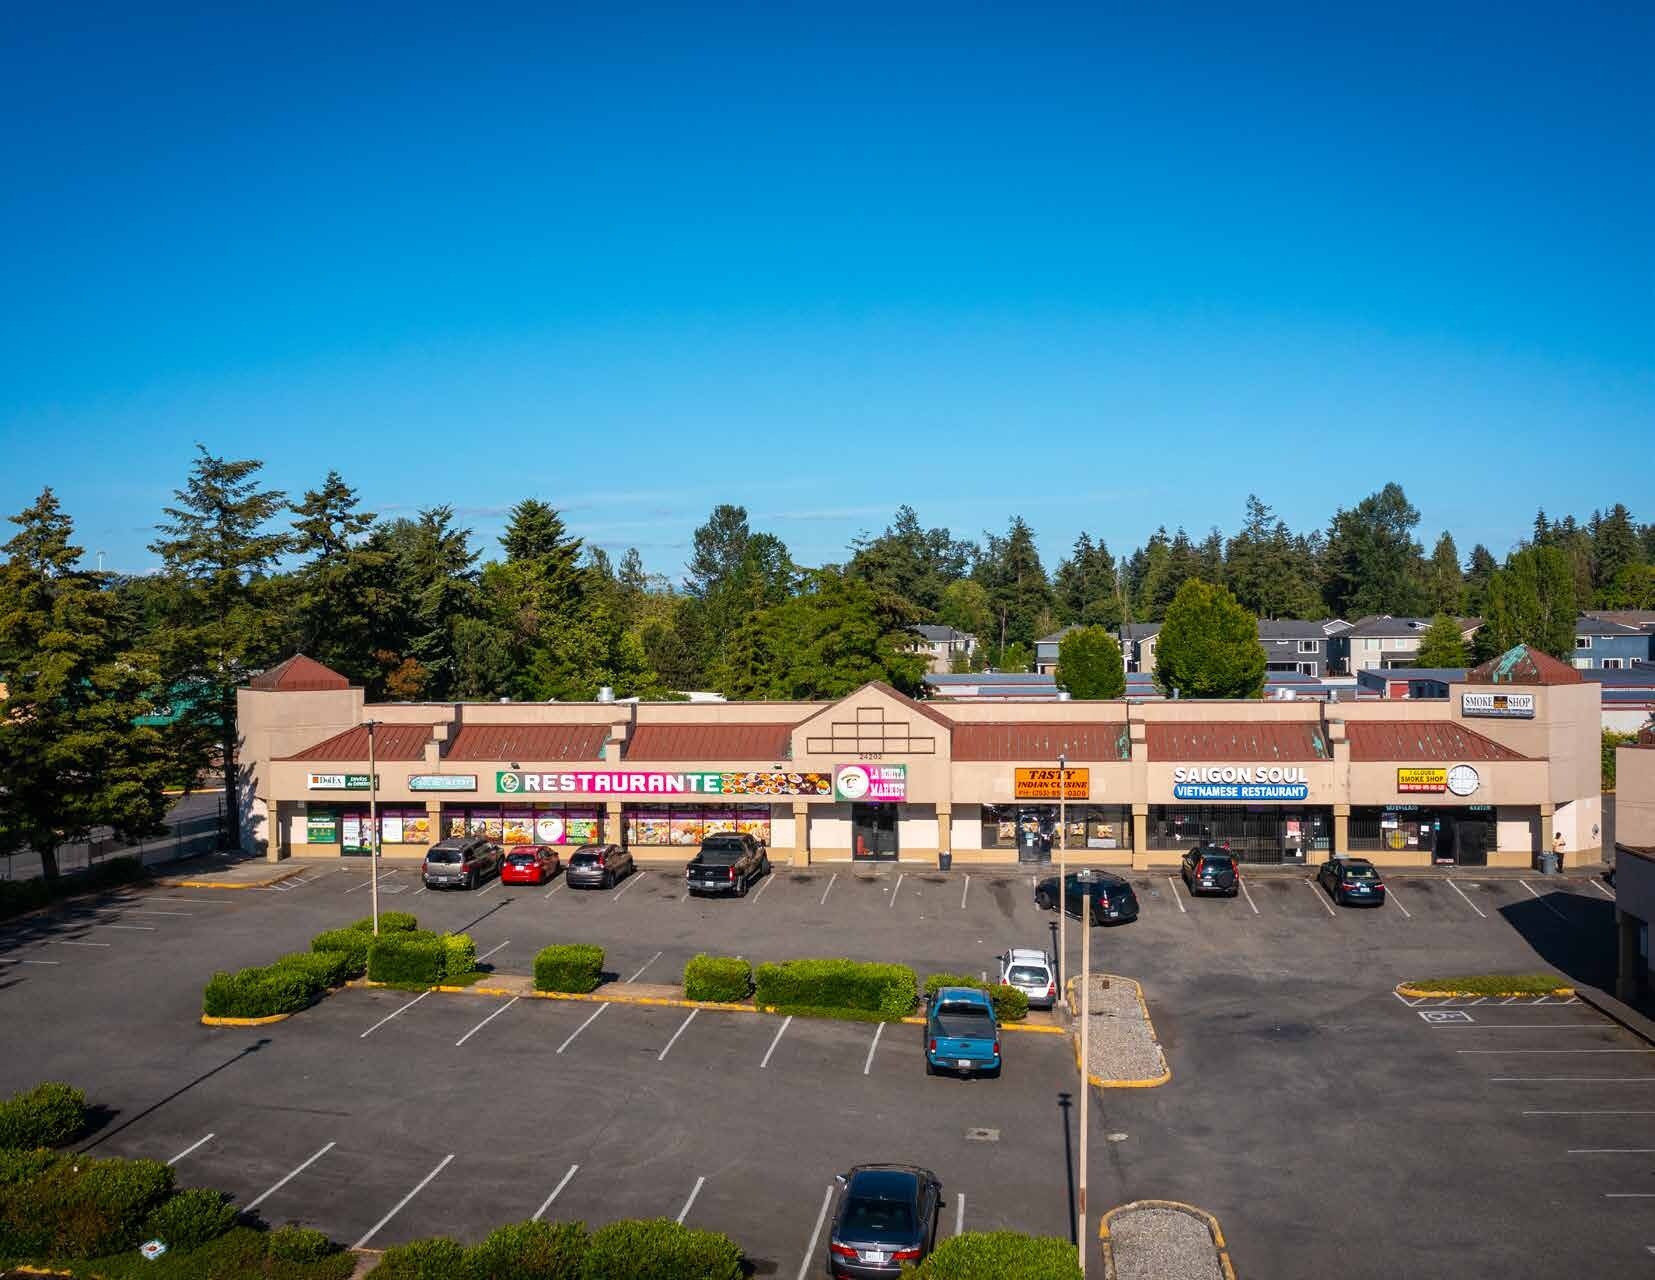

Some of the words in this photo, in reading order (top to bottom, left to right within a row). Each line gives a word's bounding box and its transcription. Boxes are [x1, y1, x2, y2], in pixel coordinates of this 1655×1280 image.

[1465, 696, 1493, 707] SMOKE
[1508, 697, 1531, 708] SHOP
[869, 768, 879, 780] LA
[1028, 770, 1076, 780] TASTY
[1174, 766, 1252, 784] SAIGON
[1255, 766, 1309, 784] SOUL
[524, 774, 721, 793] RESTAURANTE
[1017, 781, 1050, 789] INDIAN
[1051, 781, 1088, 789] CUISINE
[869, 783, 905, 797] MARKET
[1177, 786, 1239, 797] VIETNAMESE
[1241, 786, 1306, 797] RESTAURANT
